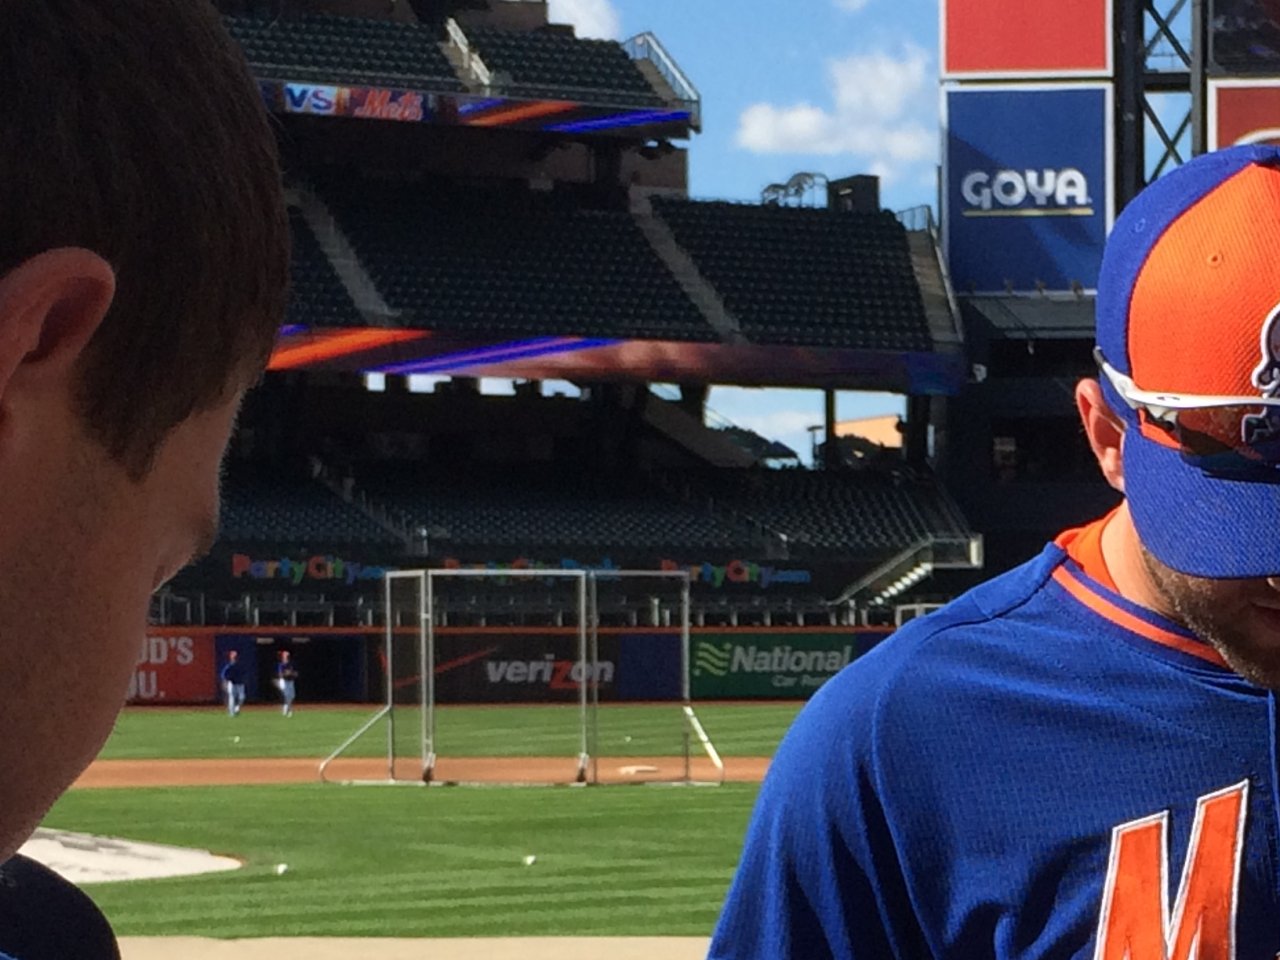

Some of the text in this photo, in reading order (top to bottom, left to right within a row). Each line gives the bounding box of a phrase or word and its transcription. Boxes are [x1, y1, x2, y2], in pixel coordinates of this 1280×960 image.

[285, 87, 336, 111] VS
[961, 168, 1088, 209] GOYA
[486, 653, 614, 689] verizon
[730, 645, 852, 673] National
